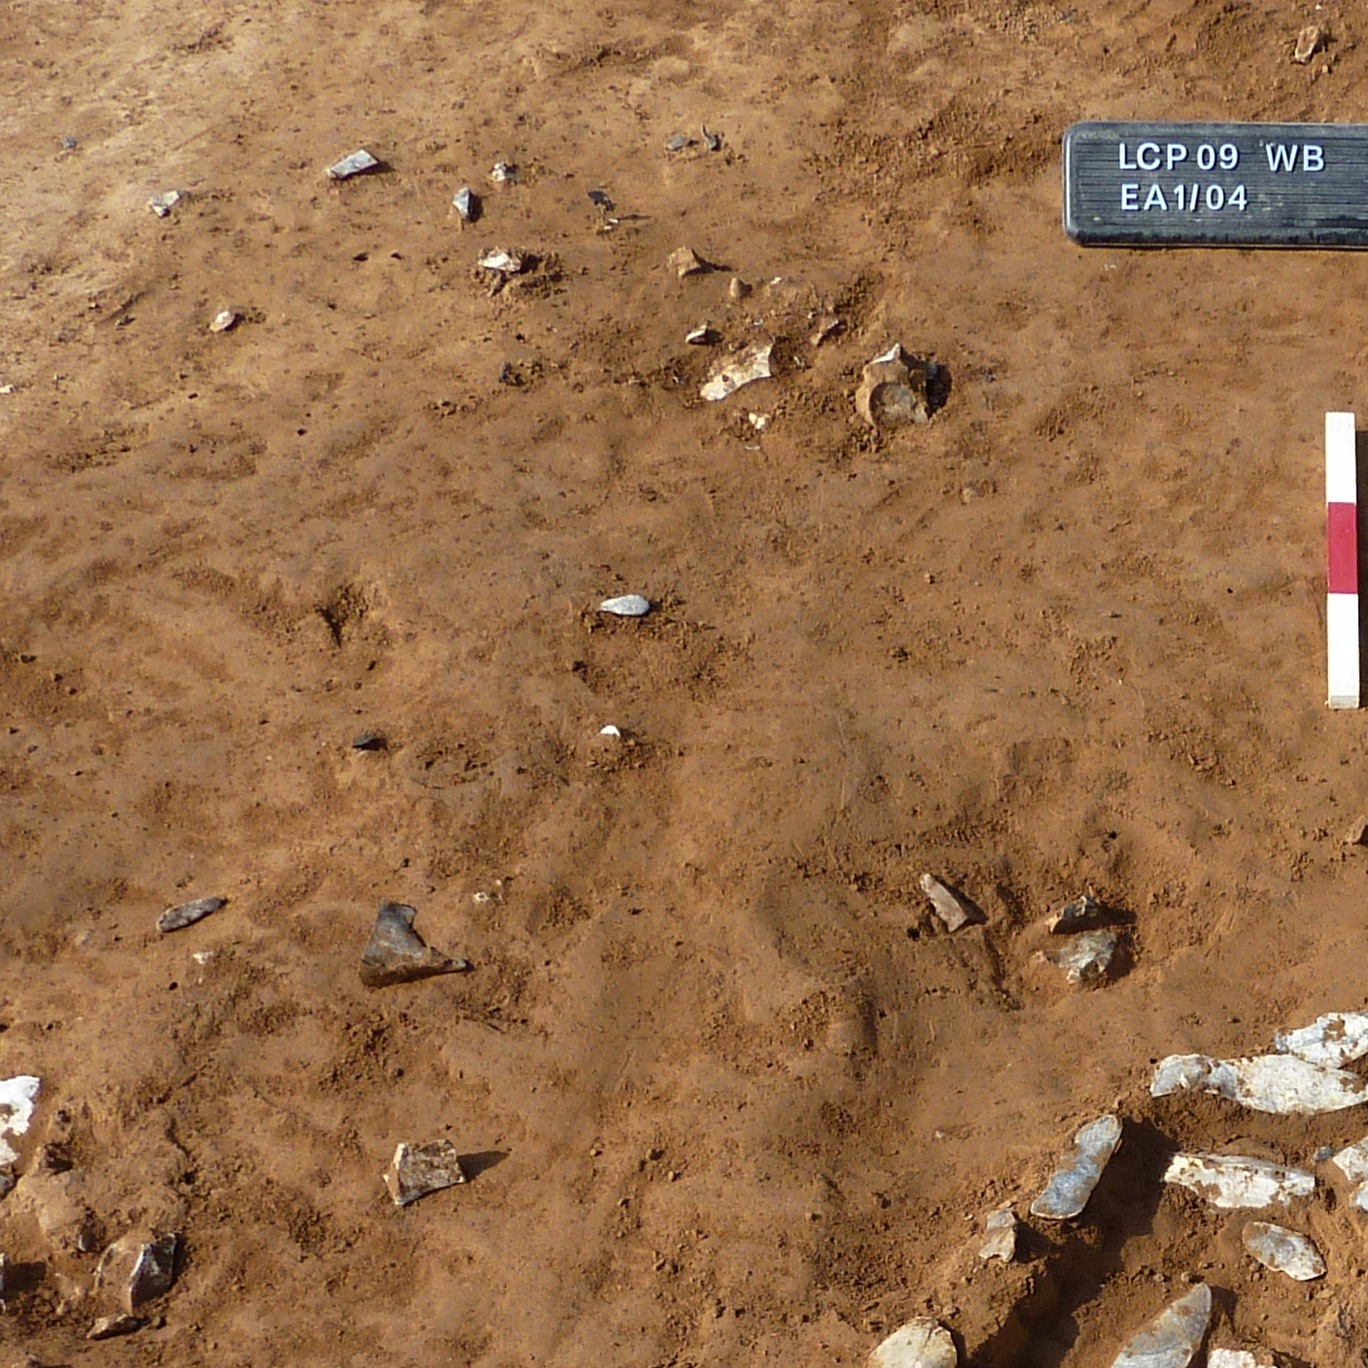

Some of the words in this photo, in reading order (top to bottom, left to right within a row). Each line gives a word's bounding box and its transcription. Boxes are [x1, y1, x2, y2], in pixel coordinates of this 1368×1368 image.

[1119, 142, 1187, 171] LCP
[1196, 143, 1238, 171] 09
[1264, 143, 1325, 172] WB
[1120, 183, 1248, 212] EA1/04
